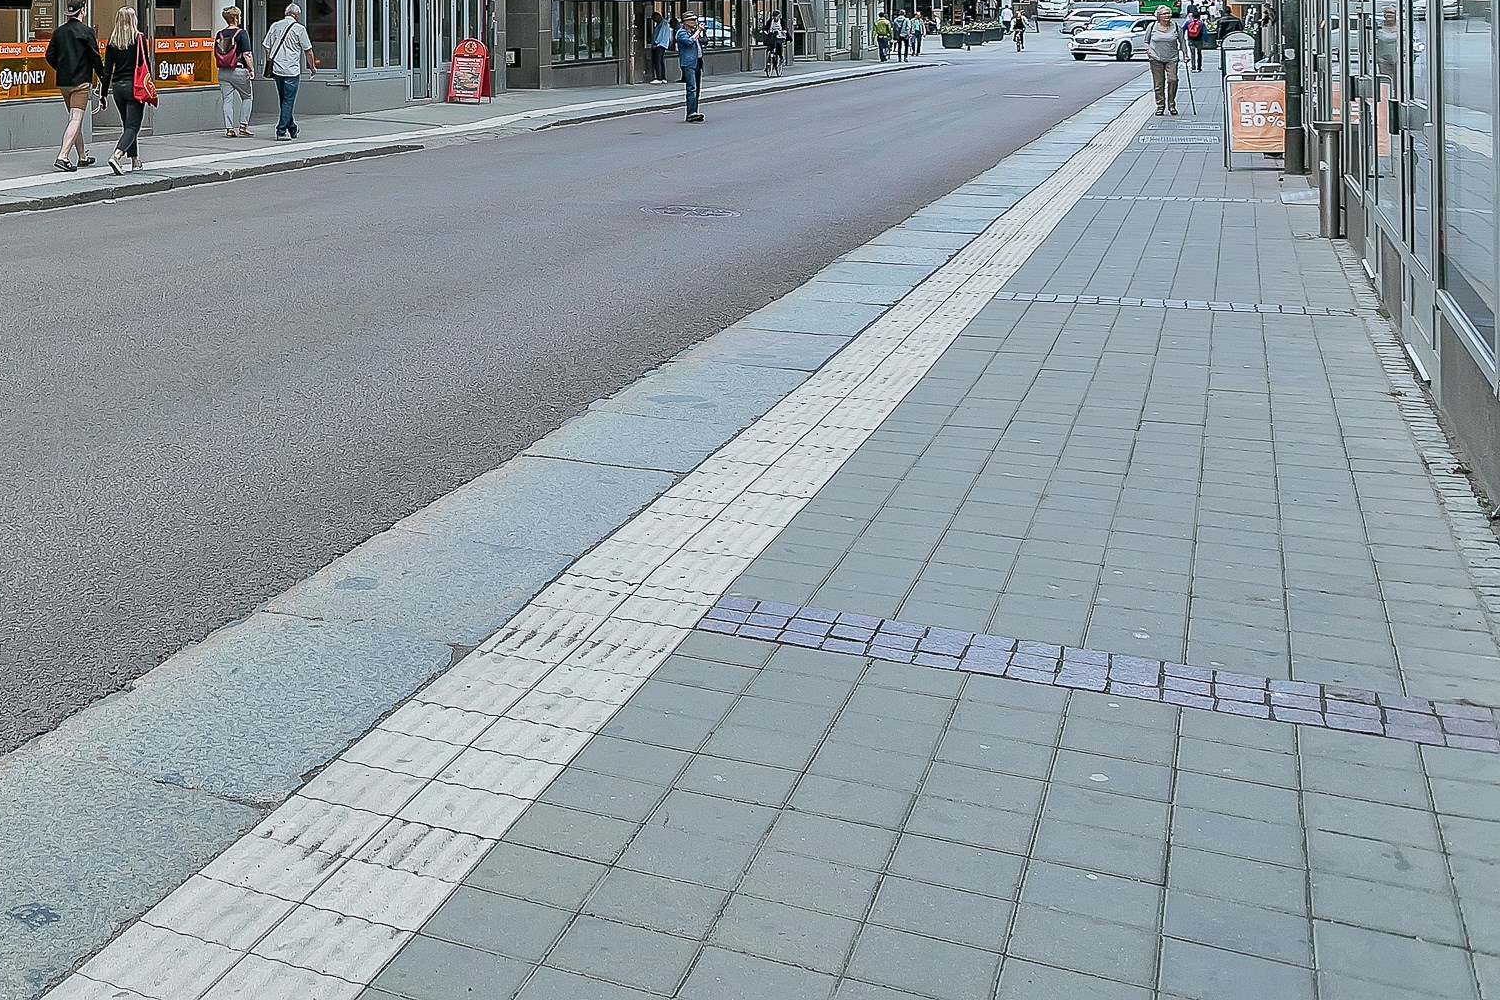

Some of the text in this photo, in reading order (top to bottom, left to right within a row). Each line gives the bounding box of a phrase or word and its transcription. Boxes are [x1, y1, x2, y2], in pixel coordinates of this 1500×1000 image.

[0, 45, 46, 56] Exchange Cambio
[170, 63, 195, 76] MONEY
[14, 70, 47, 85] MONEY
[1240, 101, 1284, 114] REA
[1240, 115, 1285, 127] 50%
